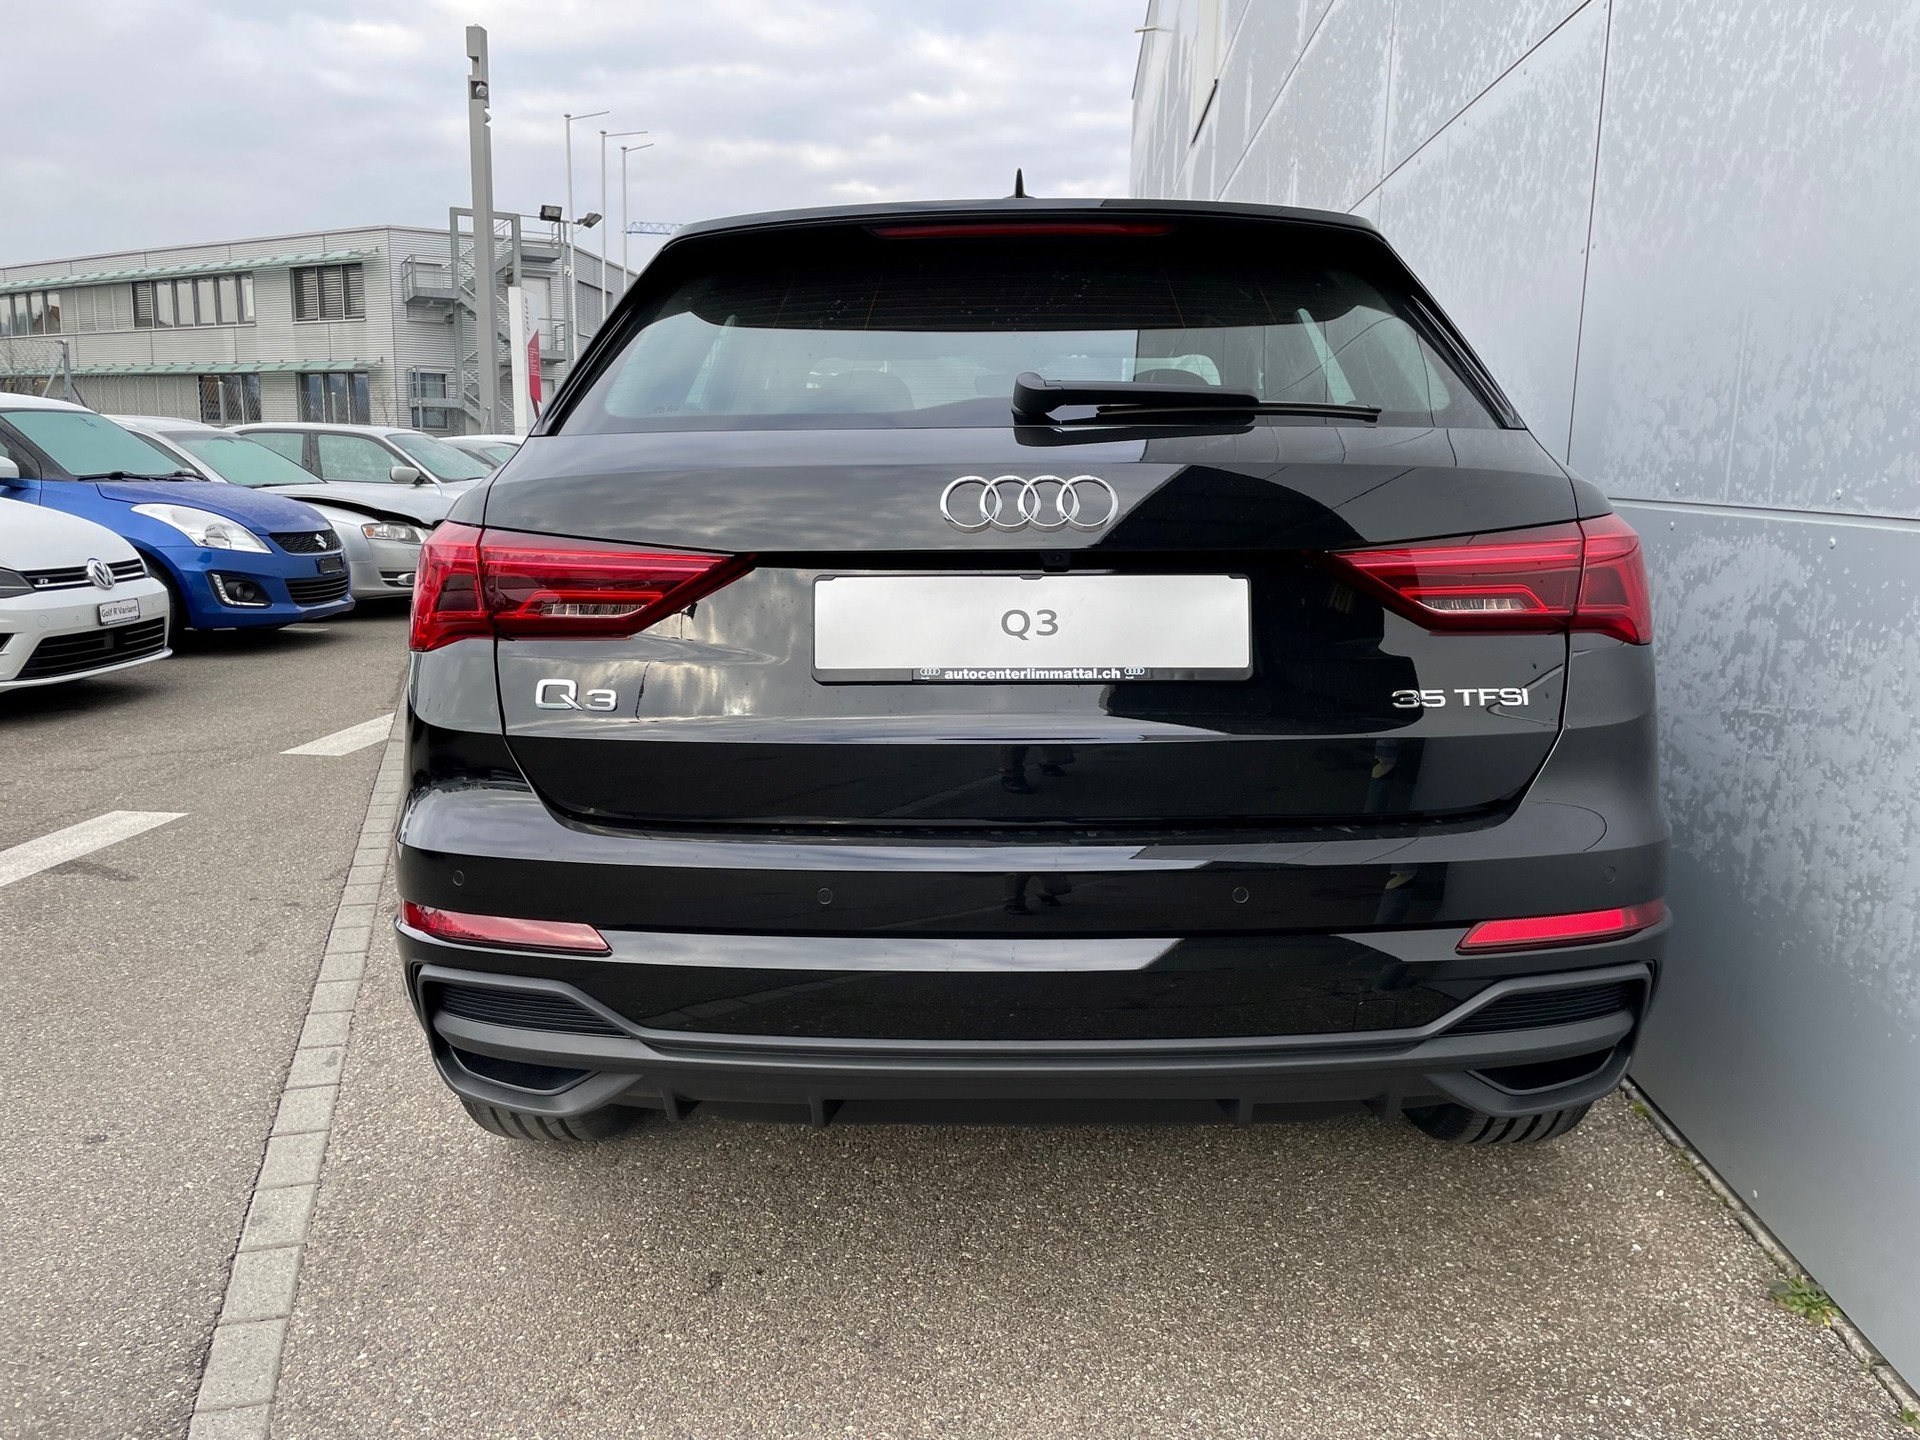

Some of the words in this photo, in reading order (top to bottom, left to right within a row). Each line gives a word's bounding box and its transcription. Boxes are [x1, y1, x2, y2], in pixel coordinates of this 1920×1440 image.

[102, 607, 113, 617] Golf
[113, 607, 118, 616] R
[118, 605, 137, 614] Variant
[1001, 609, 1058, 640] Q3
[944, 667, 1121, 680] autocenterlimmattal.ch
[535, 679, 618, 711] Q3
[1391, 689, 1447, 709] 35
[1453, 687, 1530, 707] TFSI
